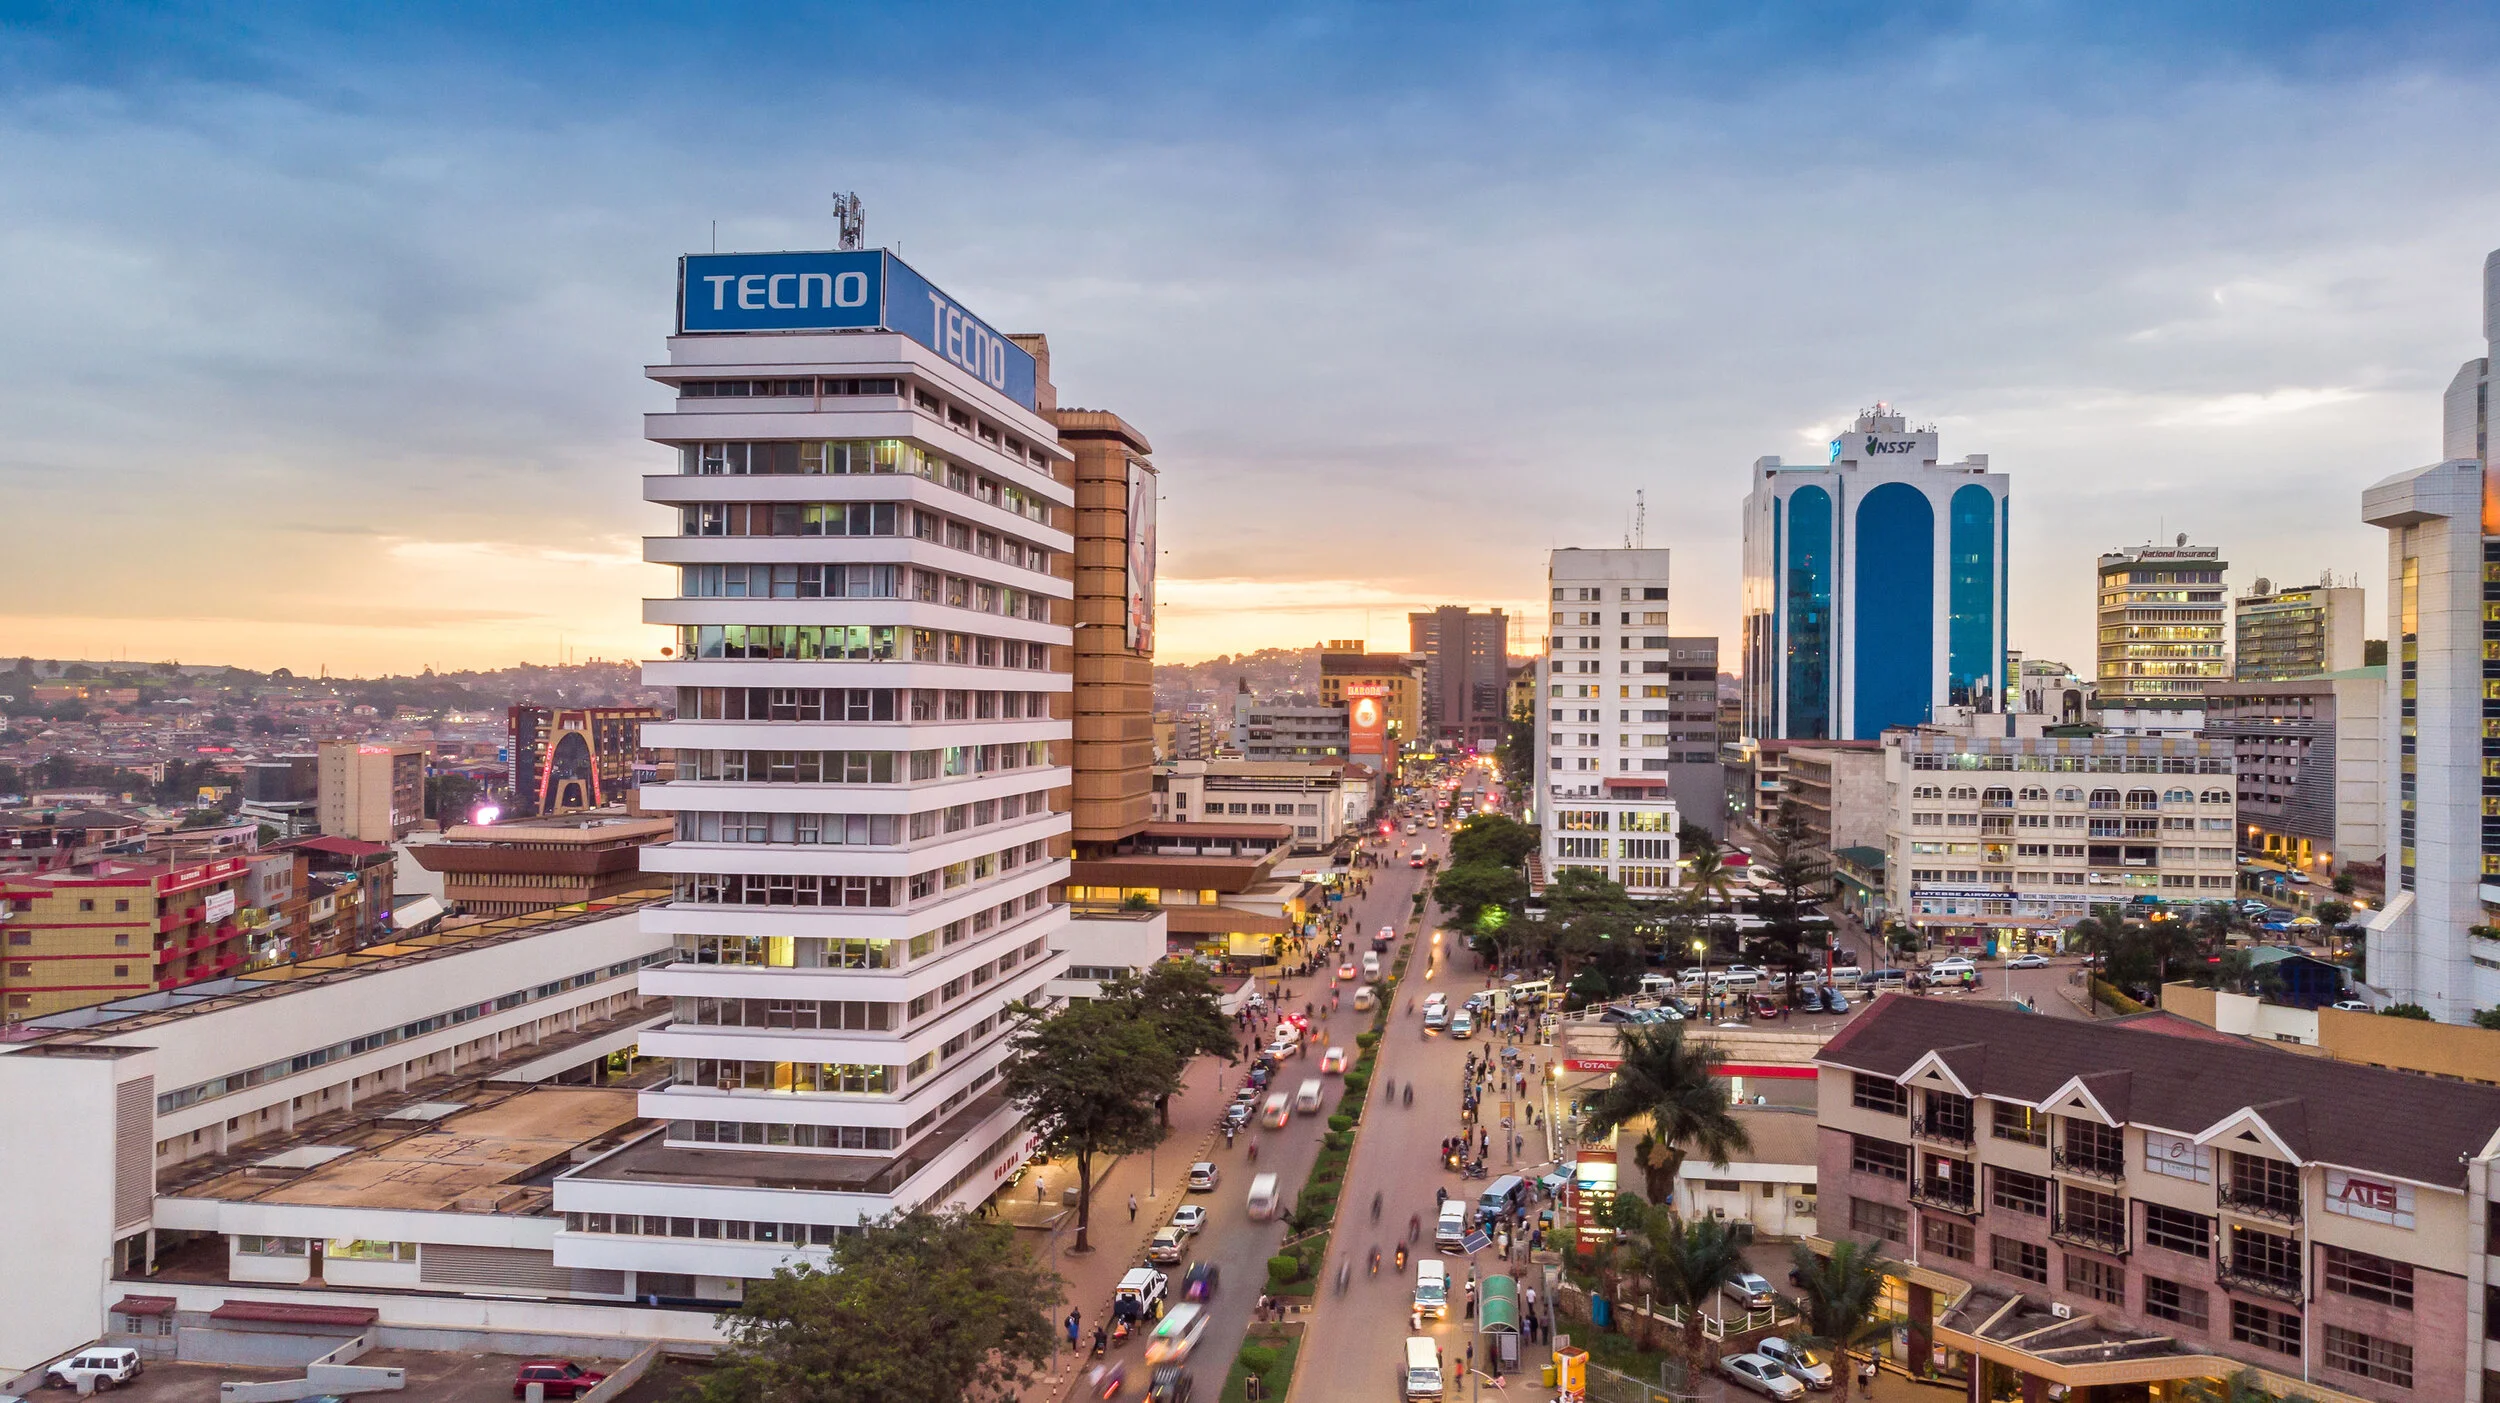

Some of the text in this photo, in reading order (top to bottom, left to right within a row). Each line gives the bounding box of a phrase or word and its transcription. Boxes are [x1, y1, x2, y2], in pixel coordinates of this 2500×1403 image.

[703, 272, 868, 311] TECNO
[928, 291, 1005, 391] TECNO
[1876, 441, 1916, 454] NSSF
[2141, 550, 2216, 558] National Insurance
[2109, 895, 2132, 903] Studio
[1577, 1061, 1613, 1070] TOTAL
[1580, 1143, 1615, 1151] TOTAL
[994, 1151, 1019, 1181] UGANDA
[2340, 1178, 2398, 1215] ATS
